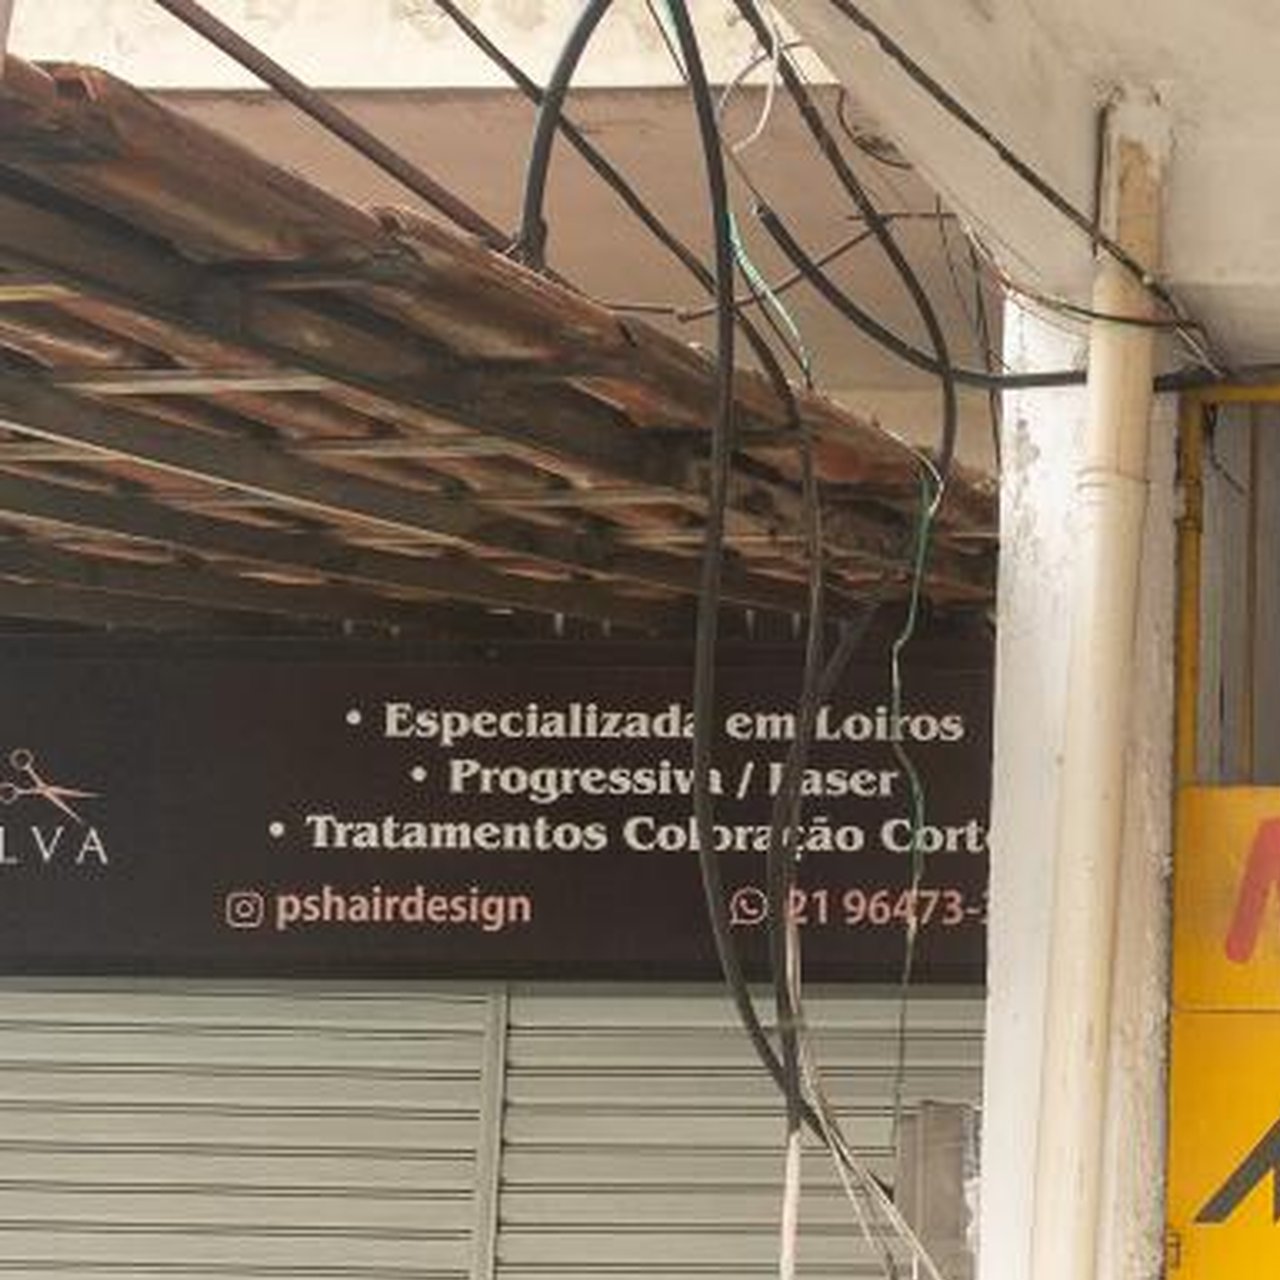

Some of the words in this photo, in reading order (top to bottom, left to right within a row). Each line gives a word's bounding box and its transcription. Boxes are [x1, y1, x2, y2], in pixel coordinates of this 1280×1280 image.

[725, 710, 795, 741] em
[305, 814, 608, 850] Tratamentos
[880, 818, 989, 852] Cort
[276, 885, 533, 932] pshairdesign
